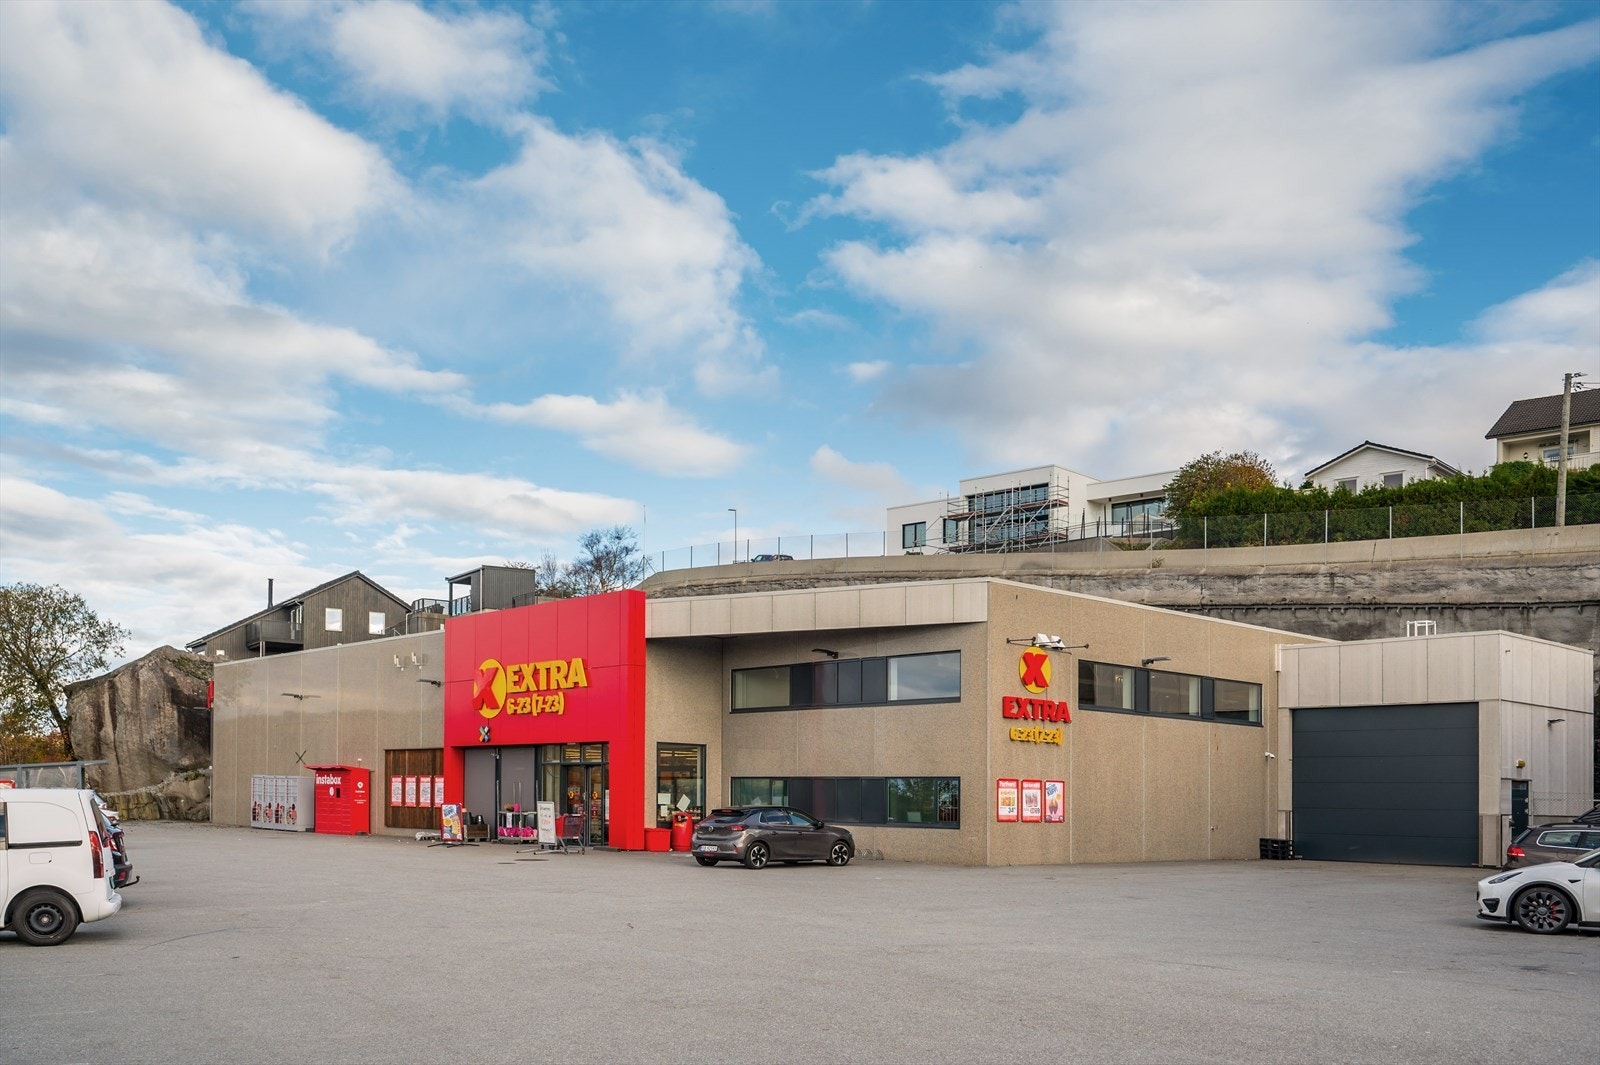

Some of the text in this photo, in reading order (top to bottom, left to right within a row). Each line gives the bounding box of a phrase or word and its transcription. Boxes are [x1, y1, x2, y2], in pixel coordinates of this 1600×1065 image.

[506, 658, 588, 694] EXTRA
[1022, 652, 1049, 688] X
[472, 667, 500, 710] X
[1002, 696, 1071, 723] EXTRA
[316, 774, 341, 785] instabox
